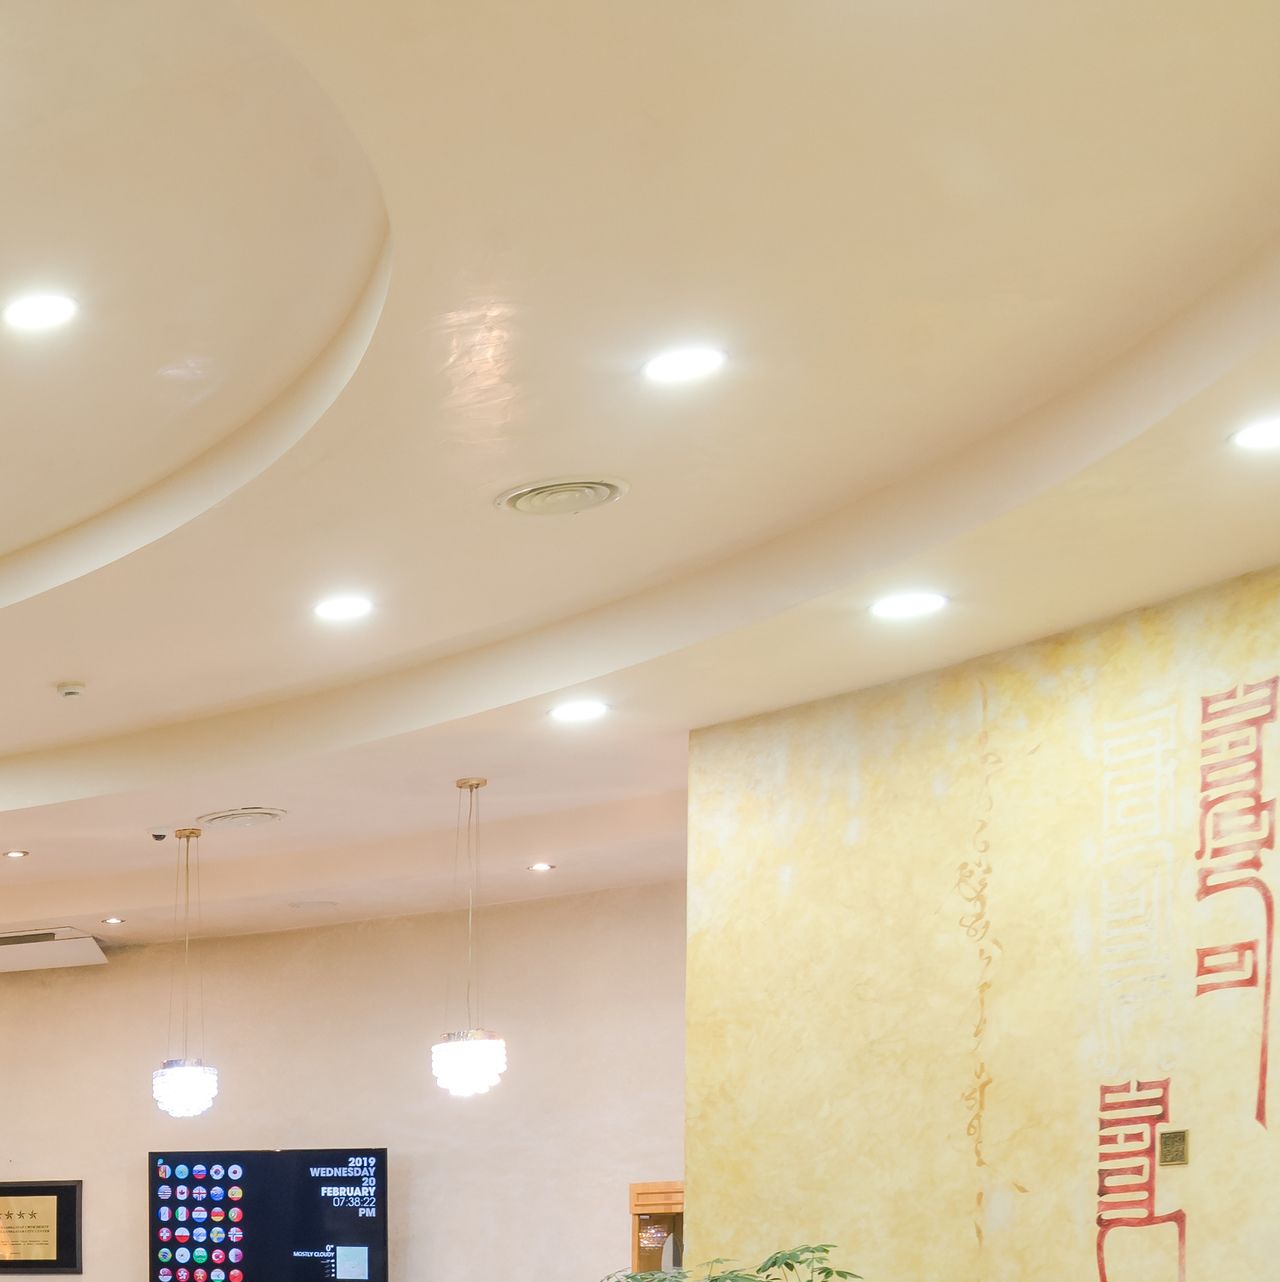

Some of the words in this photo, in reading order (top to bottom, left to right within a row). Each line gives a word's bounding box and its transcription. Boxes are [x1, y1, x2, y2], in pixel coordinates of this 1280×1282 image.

[348, 1157, 376, 1167] 2019
[309, 1167, 376, 1177] WEDNESDAY
[361, 1177, 376, 1187] 20
[320, 1186, 376, 1197] FEBRUARY
[332, 1197, 376, 1207] 07:38:22
[358, 1207, 377, 1217] PM
